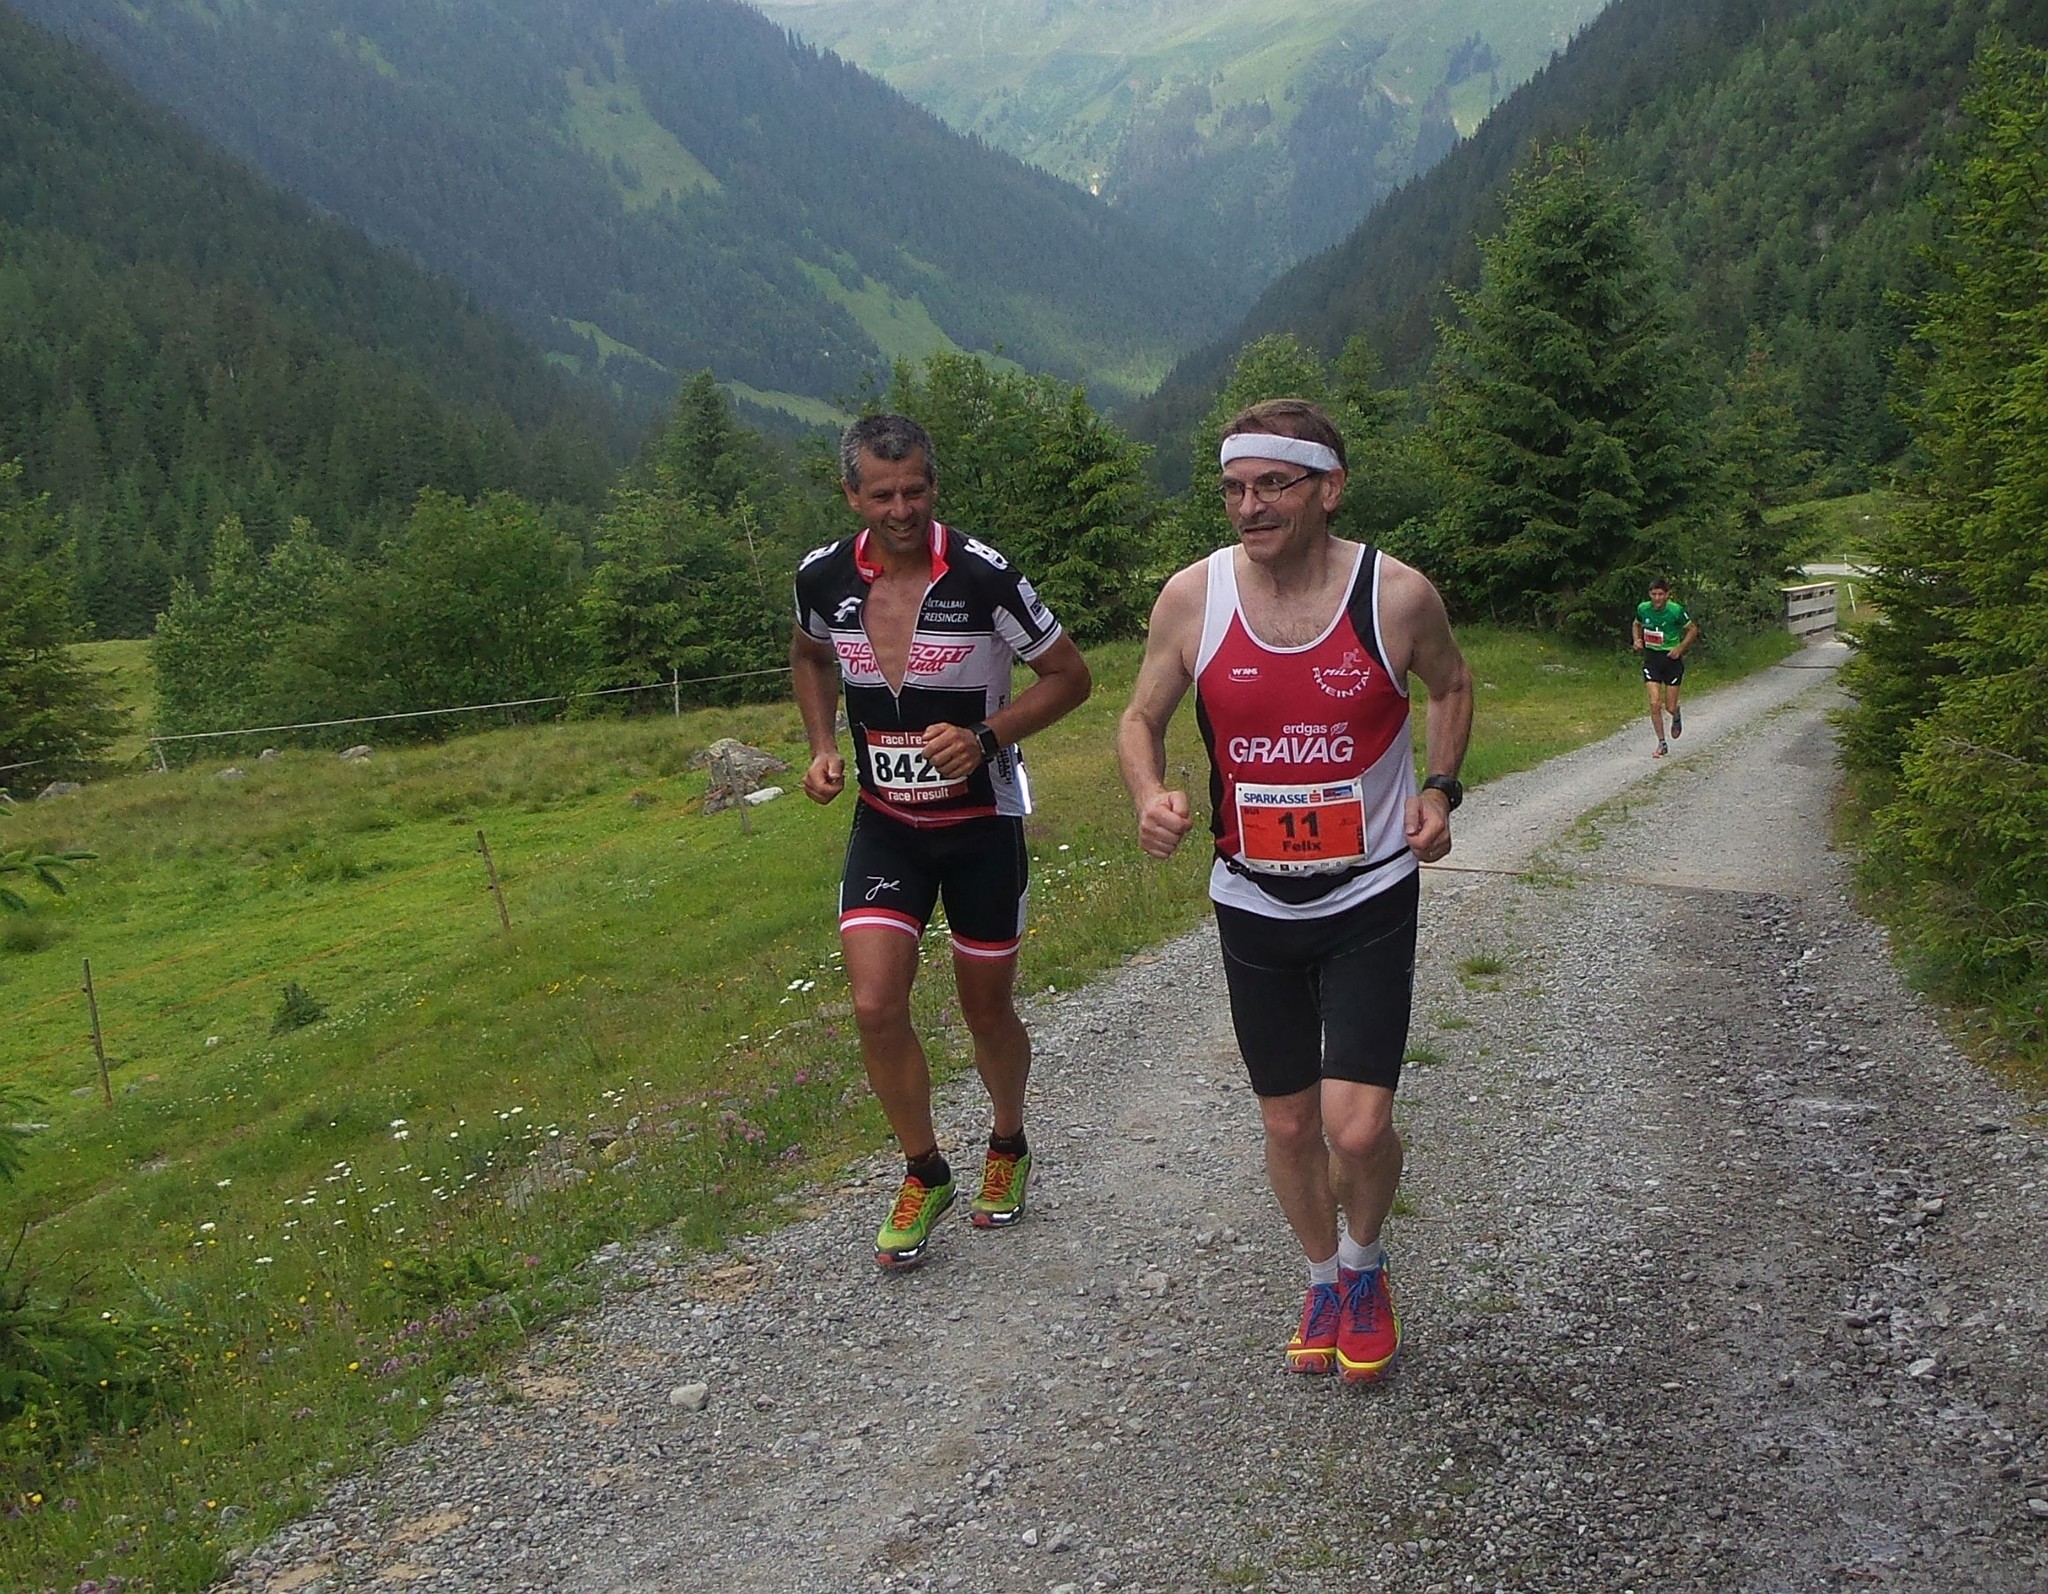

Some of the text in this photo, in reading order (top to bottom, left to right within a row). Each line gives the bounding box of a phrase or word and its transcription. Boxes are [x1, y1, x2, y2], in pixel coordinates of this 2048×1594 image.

[924, 612, 970, 623] REISINGER
[1322, 668, 1362, 677] MILA
[1312, 666, 1371, 698] RHEINTAL
[1282, 722, 1328, 737] erdgas
[1228, 735, 1355, 764] GRAVAG
[874, 751, 961, 783] 842
[916, 786, 949, 801] result
[1243, 792, 1309, 805] SPARKASSE
[1278, 810, 1319, 839] 11
[1282, 840, 1322, 853] Felix
